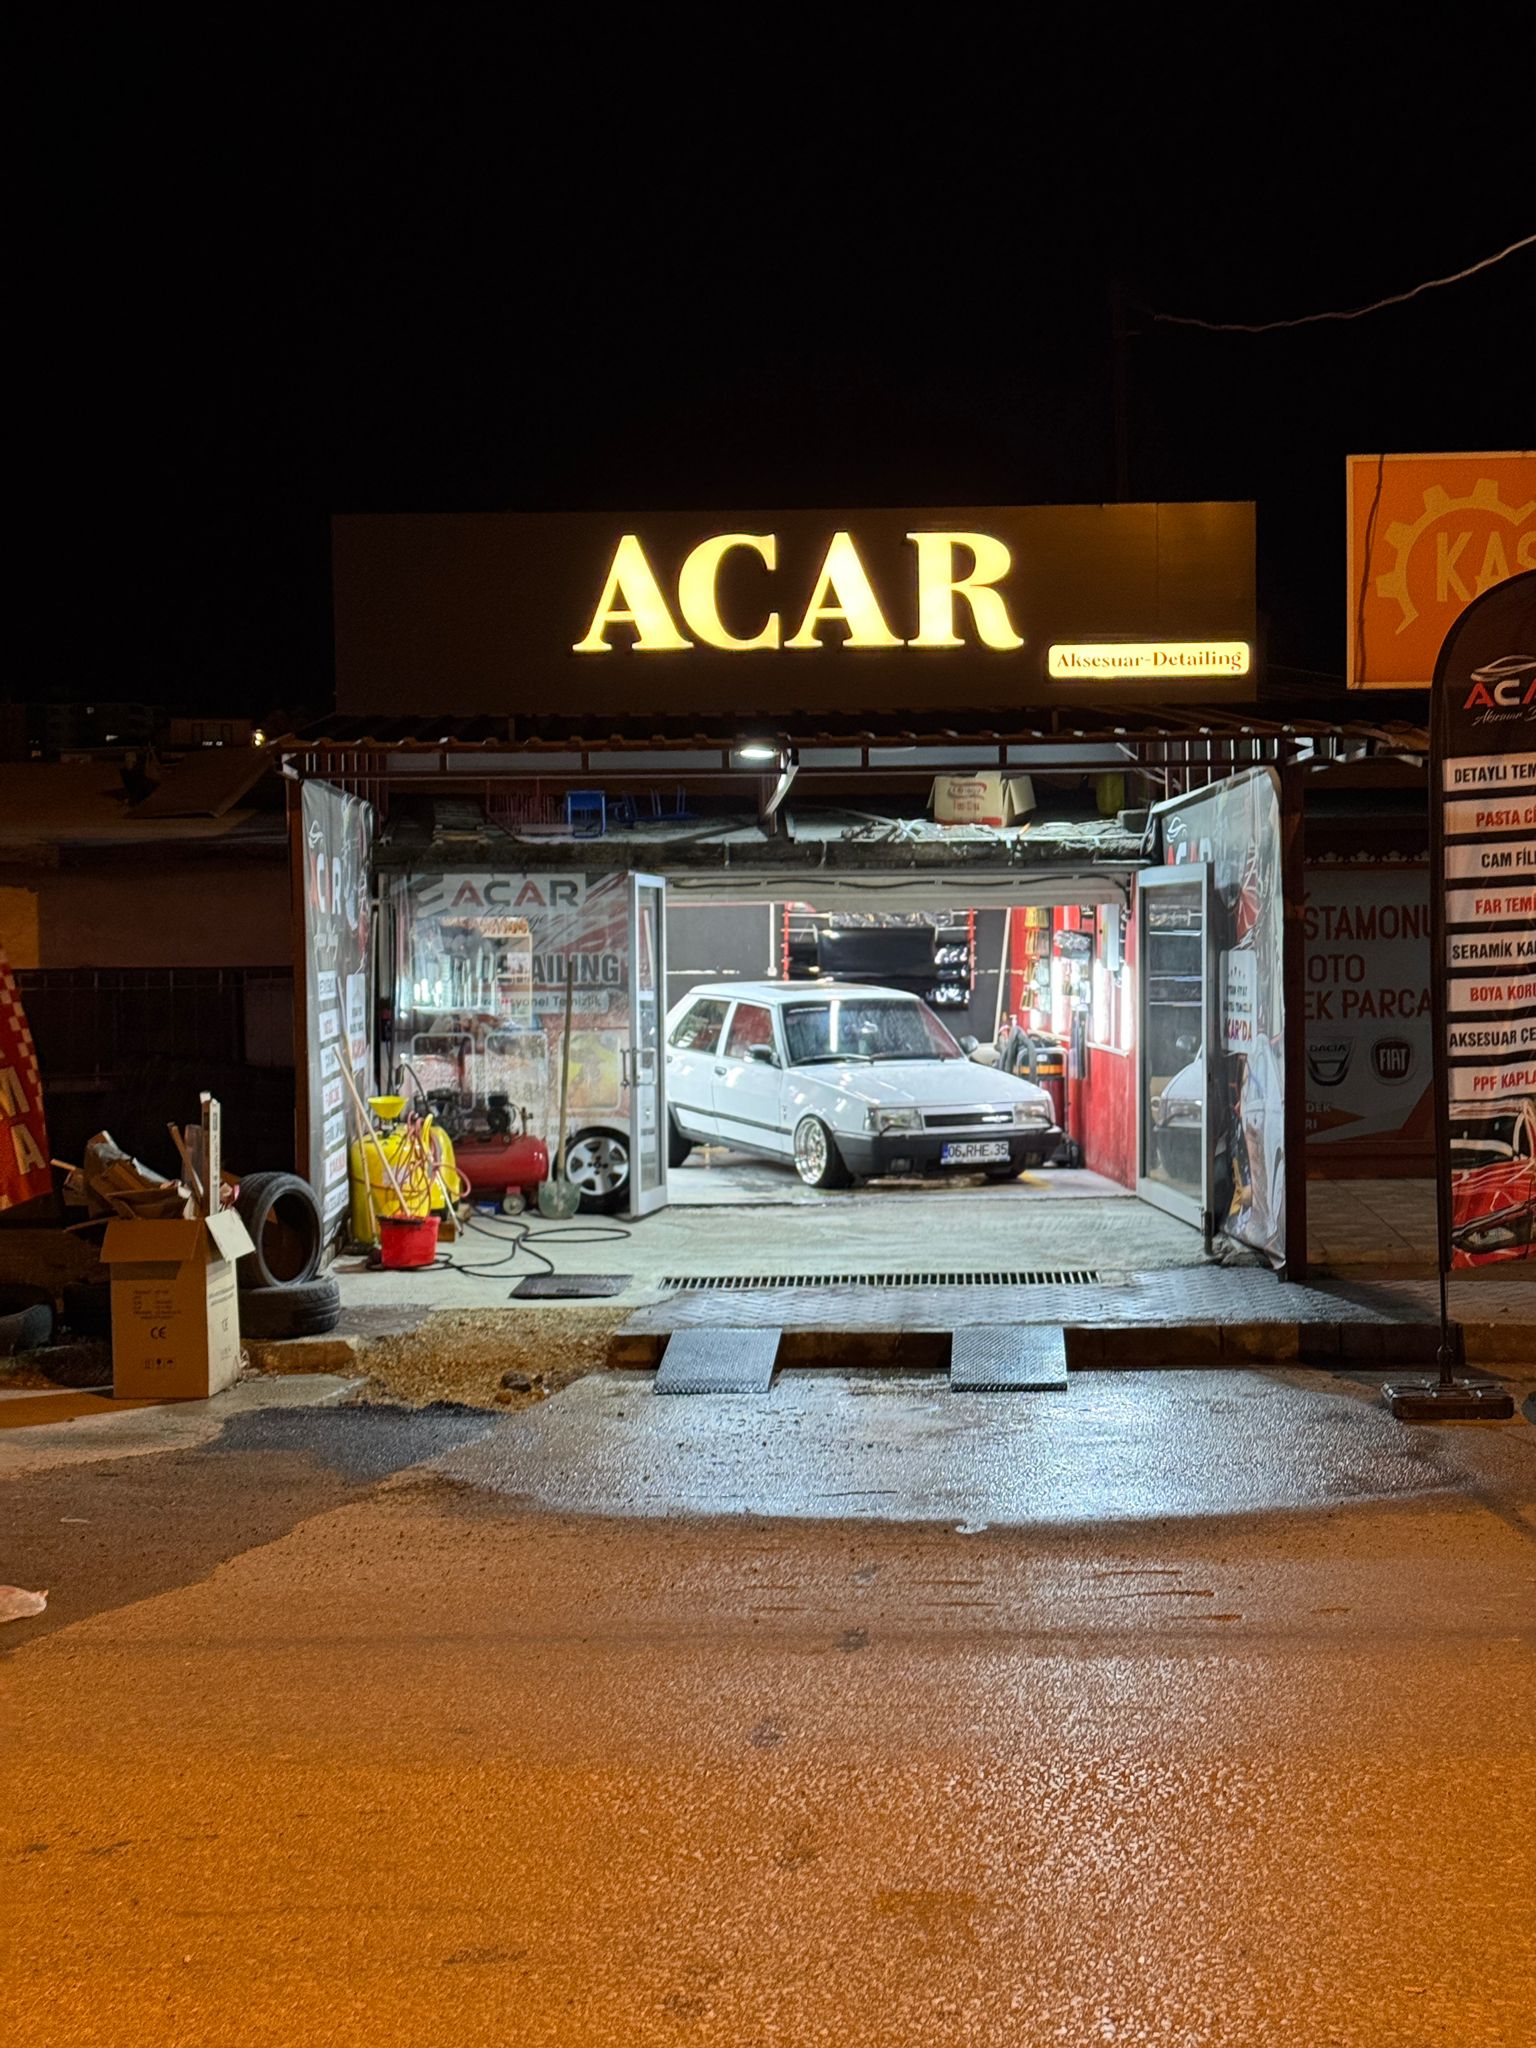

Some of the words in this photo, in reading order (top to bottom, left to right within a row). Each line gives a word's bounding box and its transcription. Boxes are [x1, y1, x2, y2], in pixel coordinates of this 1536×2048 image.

[573, 531, 1024, 653] ACAR
[1057, 651, 1242, 671] Aksesuar-Detailing
[1454, 765, 1507, 783] DETAYLI
[1476, 809, 1521, 827] PASTA
[1481, 852, 1512, 868] CAM
[1516, 847, 1536, 866] FİL
[450, 880, 579, 907] ACAR
[1475, 898, 1502, 914] FAR
[1452, 939, 1512, 959] SERAMİK
[1517, 941, 1536, 957] KA
[1308, 954, 1365, 983] OTO
[1470, 986, 1503, 1002] BOYA
[1310, 1044, 1347, 1052] DACIA
[1449, 1030, 1517, 1048] AKSESUAR
[1379, 1048, 1408, 1071] FIAT
[1473, 1075, 1497, 1091] PPF
